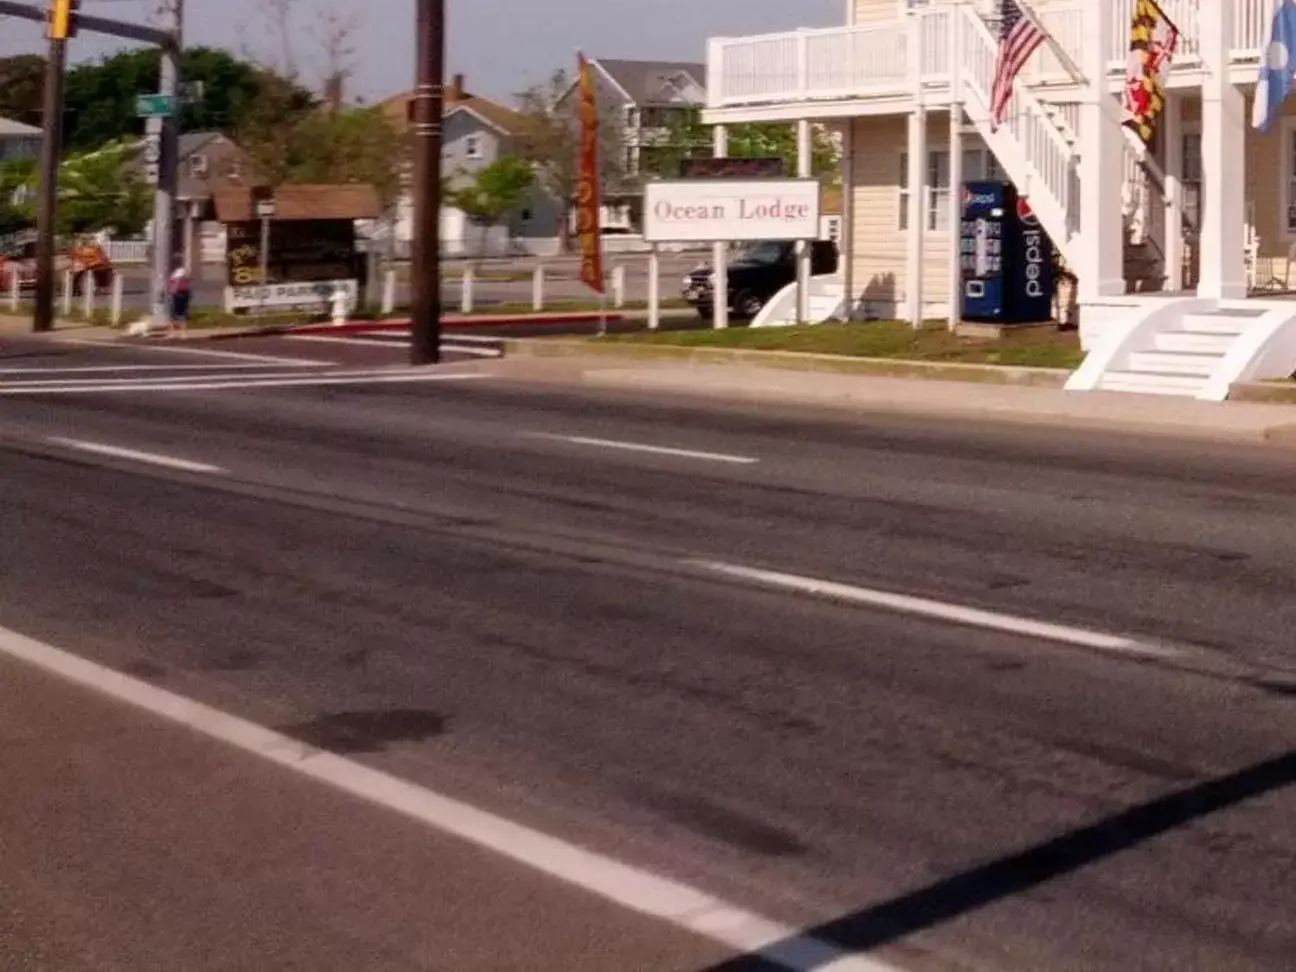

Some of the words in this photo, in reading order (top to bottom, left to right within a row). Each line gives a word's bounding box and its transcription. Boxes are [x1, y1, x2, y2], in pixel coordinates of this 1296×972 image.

[654, 200, 725, 221] Ocean
[736, 199, 810, 222] Lodge
[1022, 229, 1045, 298] pepsi
